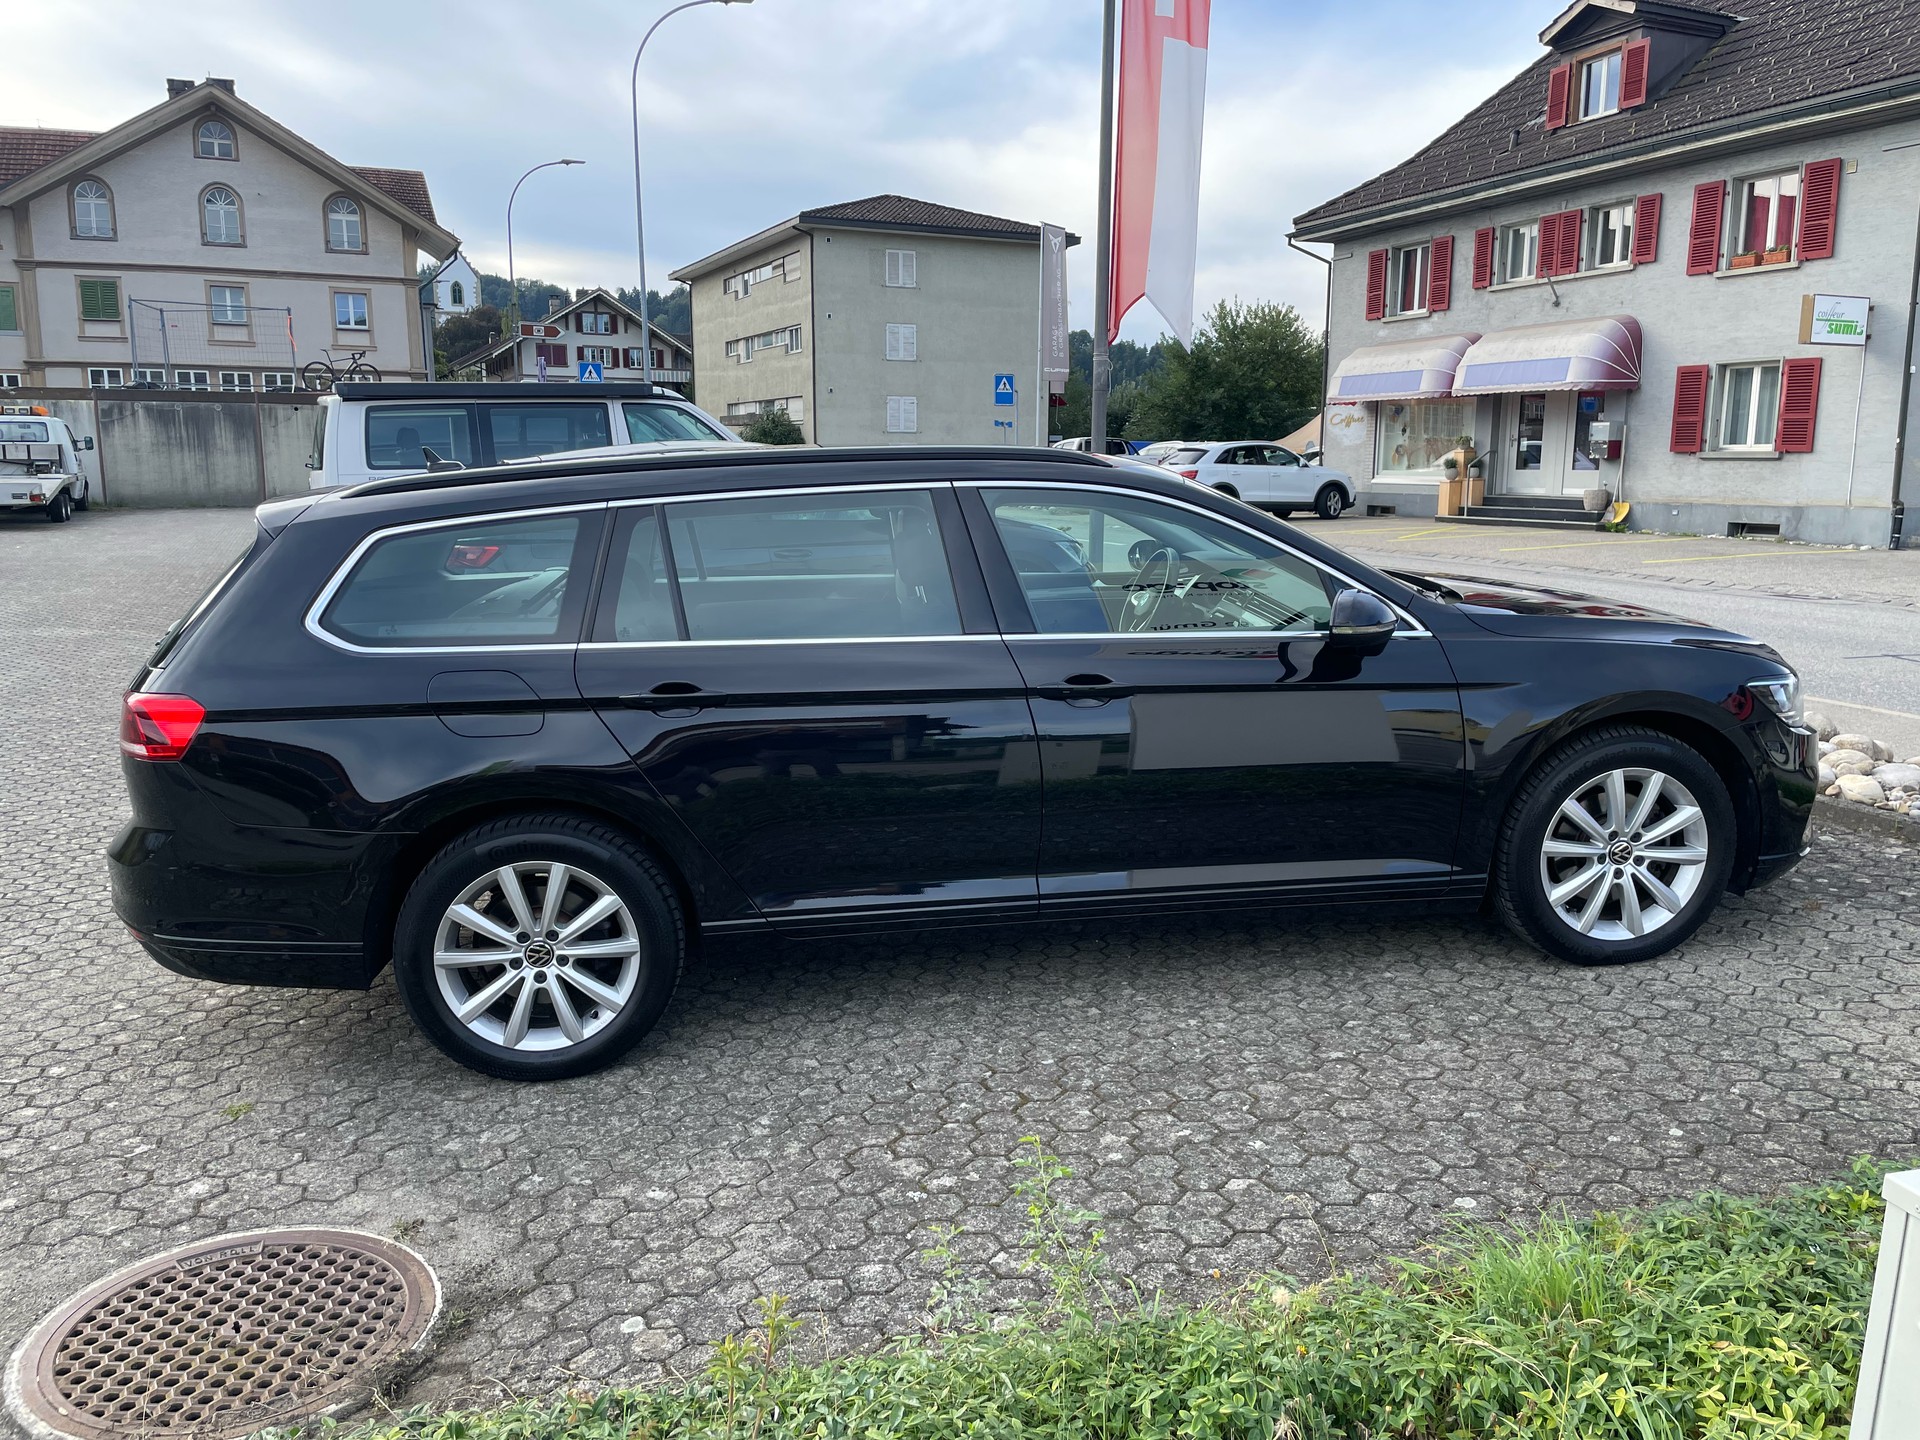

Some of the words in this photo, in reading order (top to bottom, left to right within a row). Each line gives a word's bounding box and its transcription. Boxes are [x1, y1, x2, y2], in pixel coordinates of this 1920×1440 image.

[1056, 268, 1062, 280] AG
[1056, 281, 1064, 349] GROSSENBACHER
[185, 1255, 213, 1267] VON
